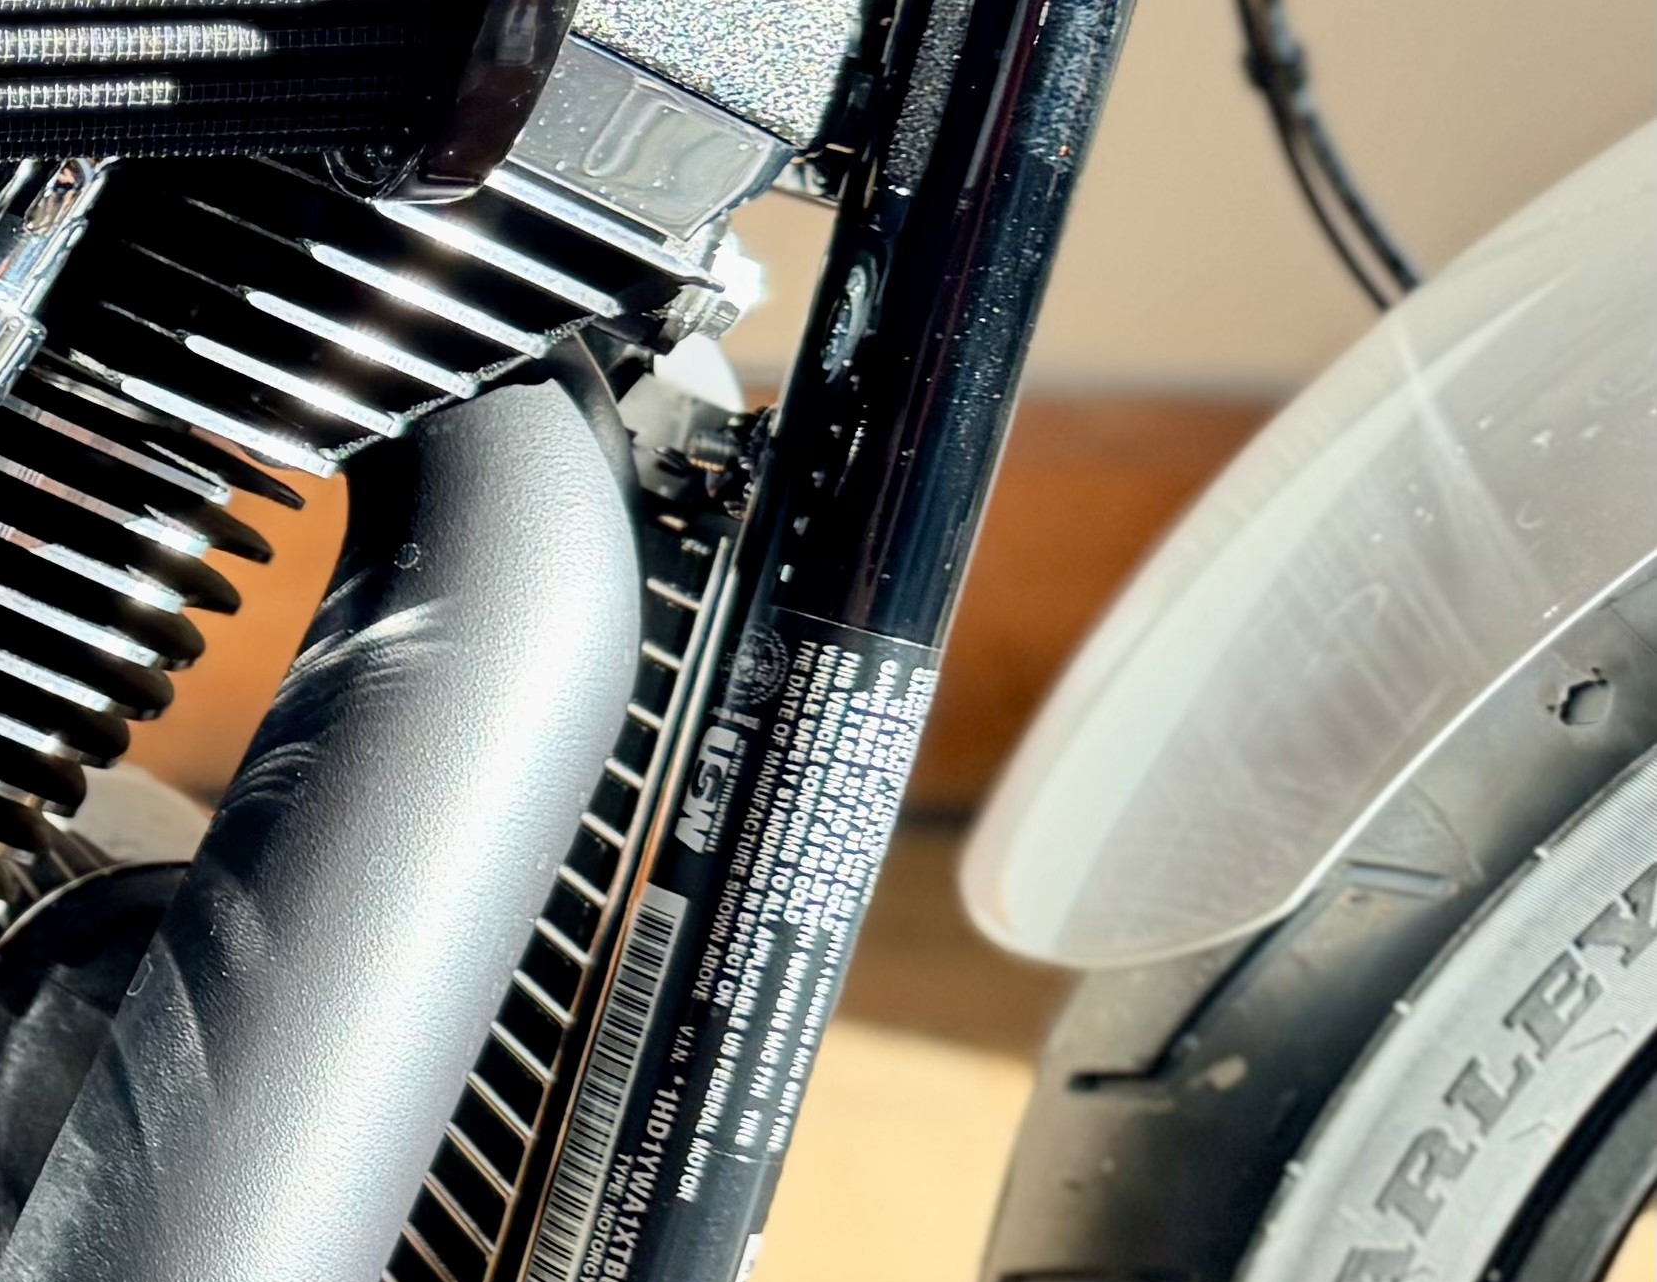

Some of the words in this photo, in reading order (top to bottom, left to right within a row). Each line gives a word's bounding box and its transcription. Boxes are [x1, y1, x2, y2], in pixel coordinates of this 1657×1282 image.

[792, 638, 817, 672] THE
[801, 642, 839, 717] VEHICLE
[832, 649, 860, 689] THIS
[777, 672, 806, 721] DATE
[866, 658, 898, 715] GAWR
[768, 721, 791, 748] OF
[780, 717, 816, 785] SAFETY
[808, 689, 848, 764] VEHICLE
[850, 713, 881, 764] REAR
[670, 722, 739, 853] USW
[820, 760, 847, 797] RIM
[729, 748, 783, 876] MANUFACTURE
[778, 763, 825, 864] CONFORMS
[813, 795, 836, 823] AT
[828, 808, 851, 836] KG
[747, 785, 795, 891] STANDARDS
[797, 842, 821, 875] PSI
[770, 862, 794, 888] TO
[781, 873, 812, 925] COLD
[708, 878, 743, 943] SHOWN
[741, 890, 762, 911] IN
[758, 888, 786, 927] ALL
[793, 901, 822, 949] WITH
[818, 883, 844, 931] COLD
[720, 910, 756, 977] EFFECT
[690, 943, 723, 1002] ABOVE
[711, 977, 735, 1008] ON
[726, 924, 775, 1030] APPLICABLE
[668, 1023, 696, 1067] V.I.N.
[718, 1030, 742, 1057] US
[694, 1056, 734, 1137] FEDERAL
[732, 1106, 760, 1147] TIRE
[674, 1136, 709, 1202] MOTOR
